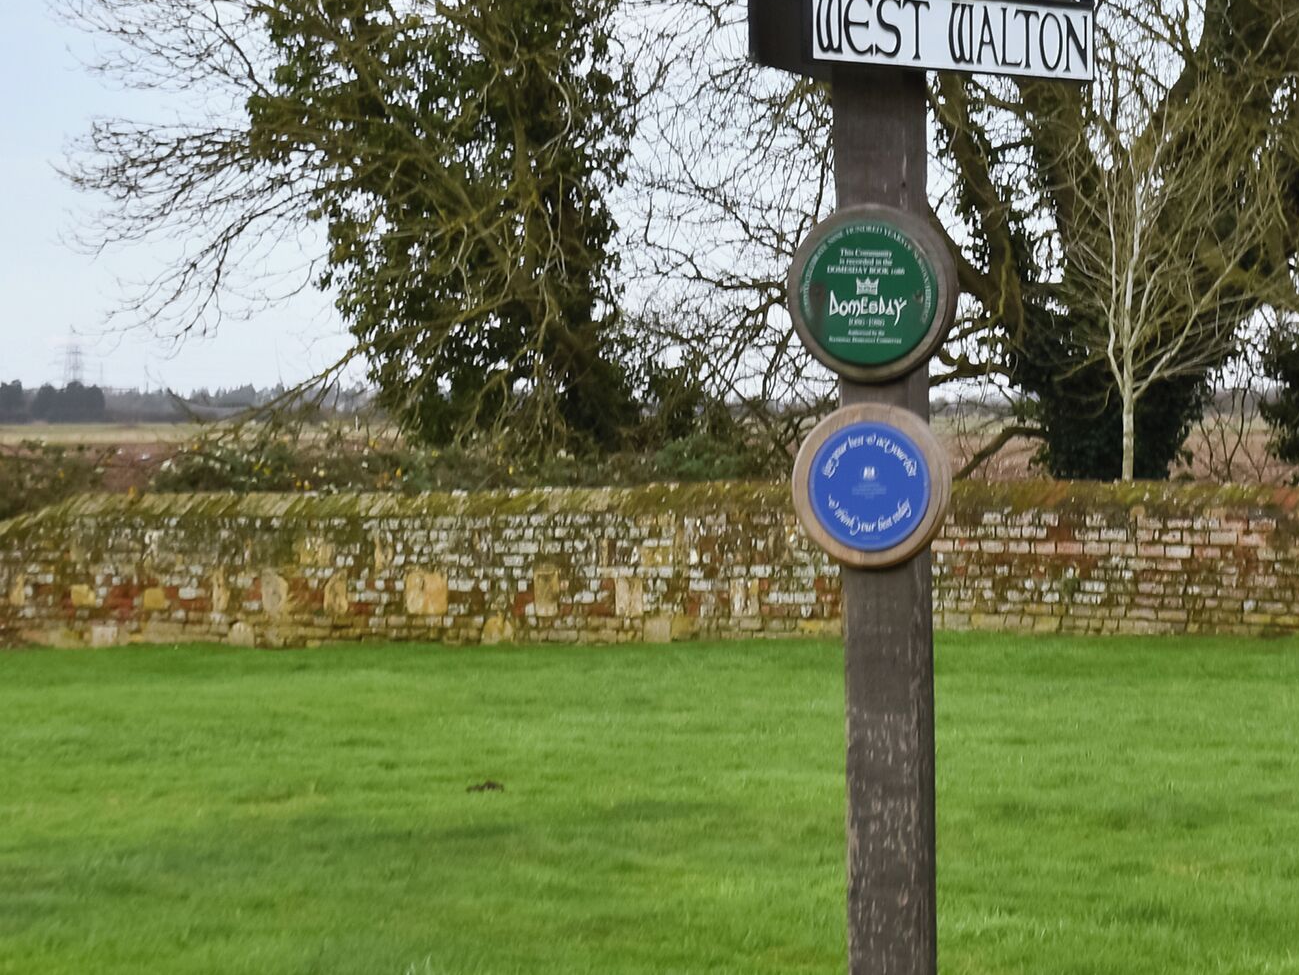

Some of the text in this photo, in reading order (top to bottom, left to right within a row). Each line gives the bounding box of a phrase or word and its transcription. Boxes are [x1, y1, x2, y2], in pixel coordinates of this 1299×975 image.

[948, 2, 1089, 73] WALTON
[840, 248, 892, 259] This Community
[826, 265, 868, 274] DOMESDAY
[868, 266, 889, 275] BOOK
